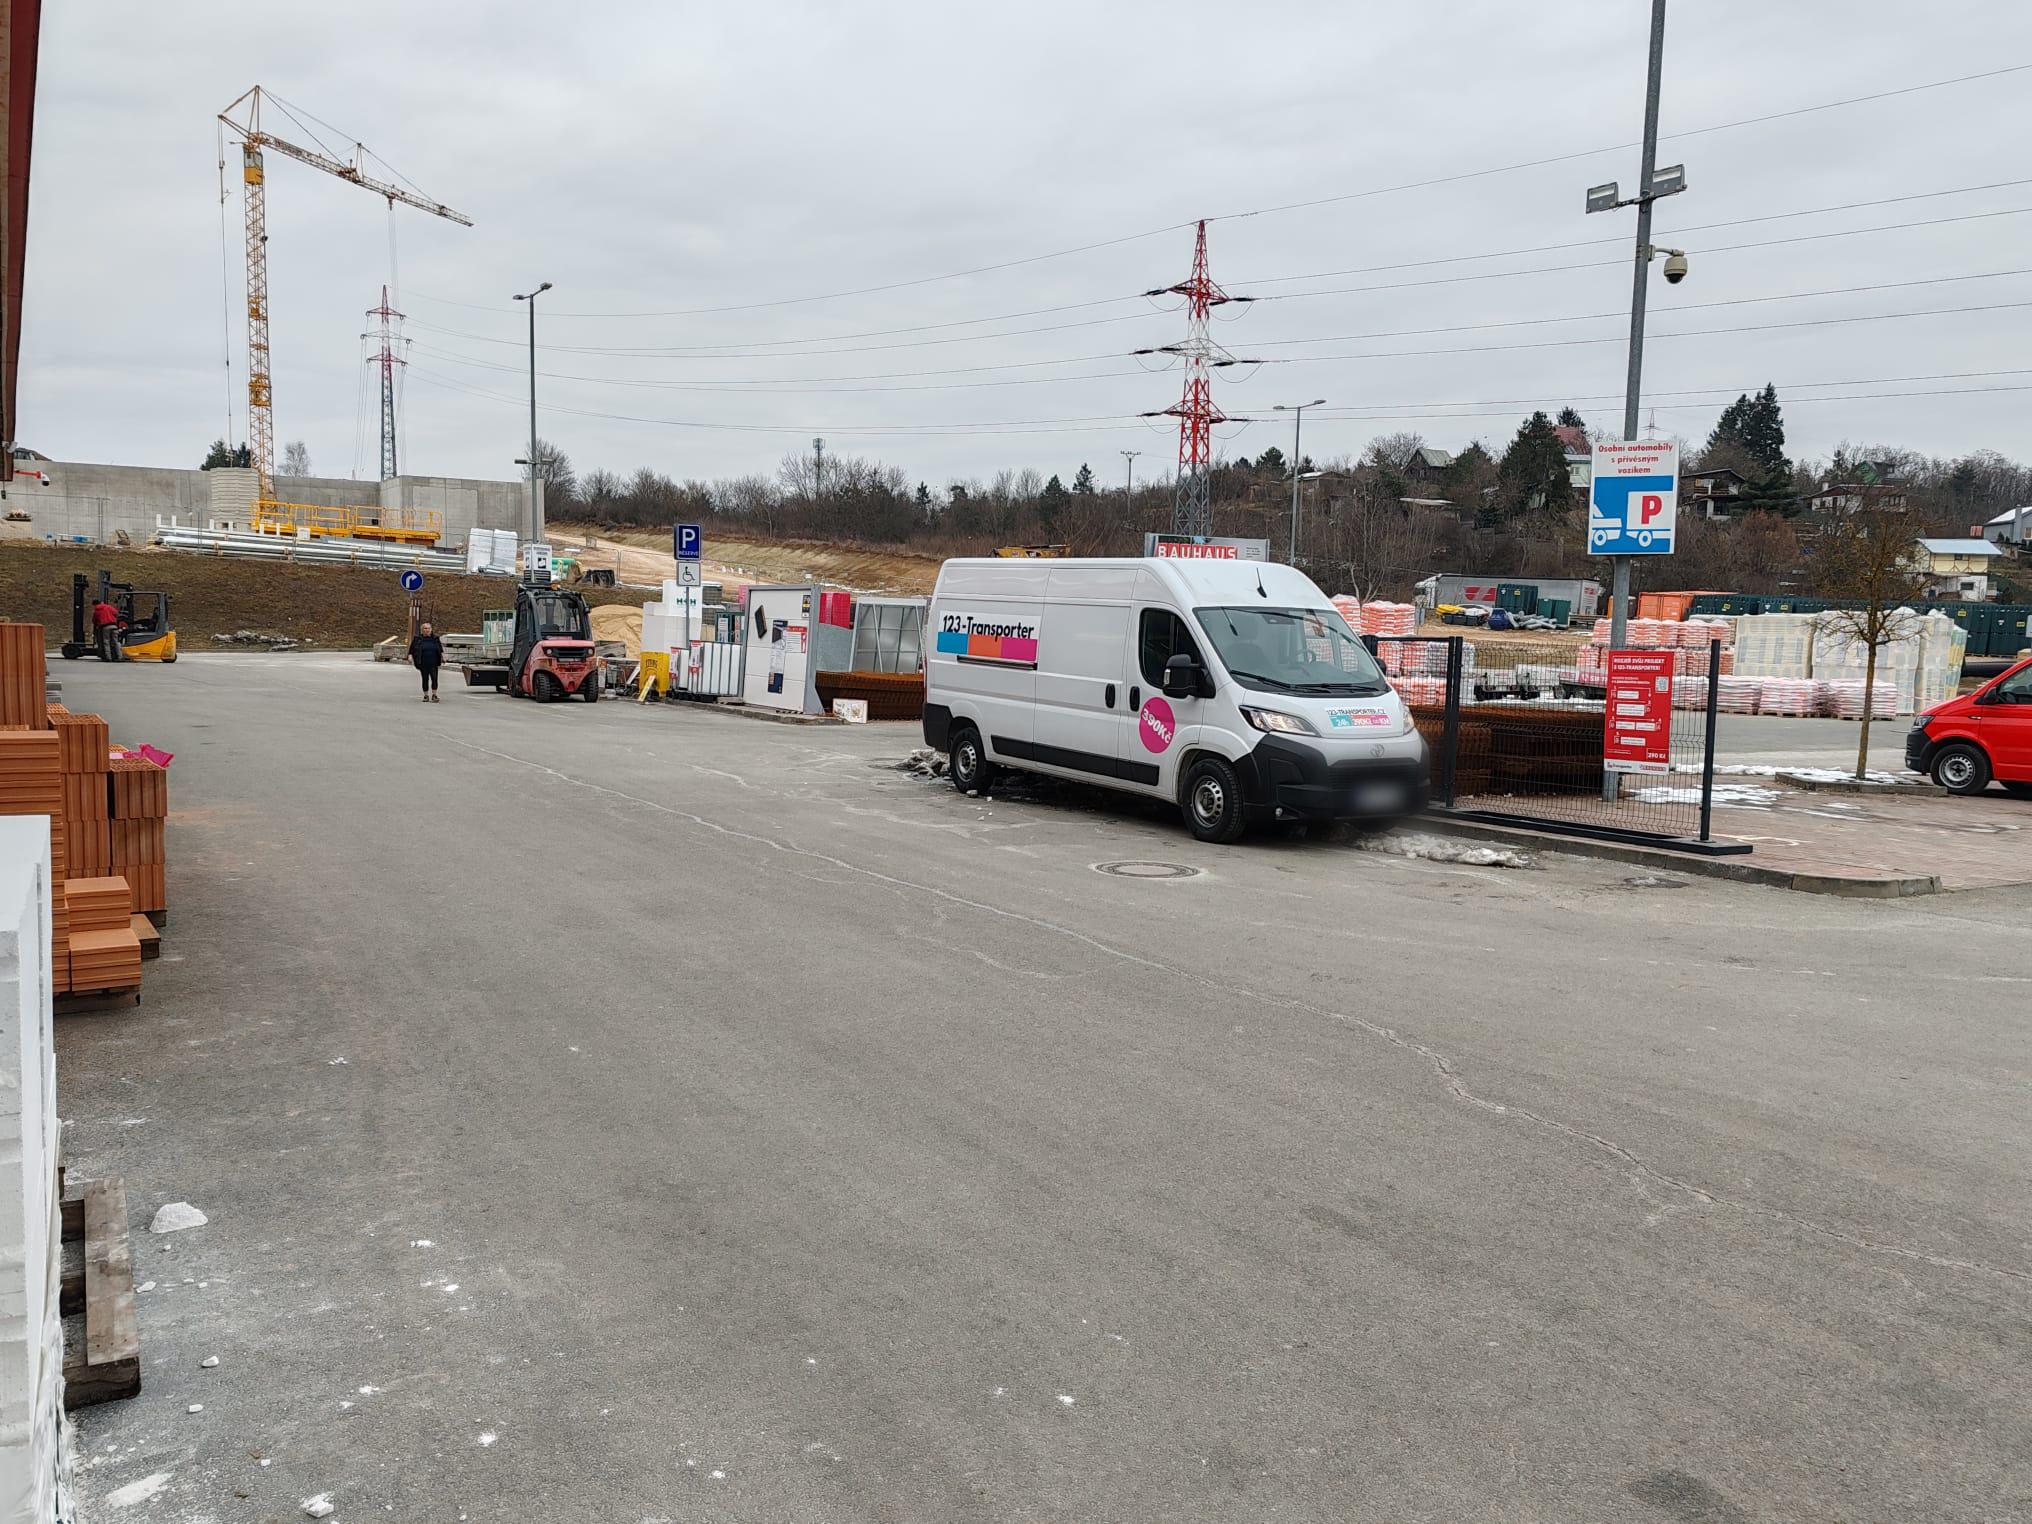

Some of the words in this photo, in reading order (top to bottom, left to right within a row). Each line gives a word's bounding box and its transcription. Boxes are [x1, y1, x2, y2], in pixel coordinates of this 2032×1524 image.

[1627, 443, 1673, 452] automobily
[1641, 495, 1662, 525] P
[682, 528, 696, 549] P
[1158, 544, 1236, 559] BAUHAUS
